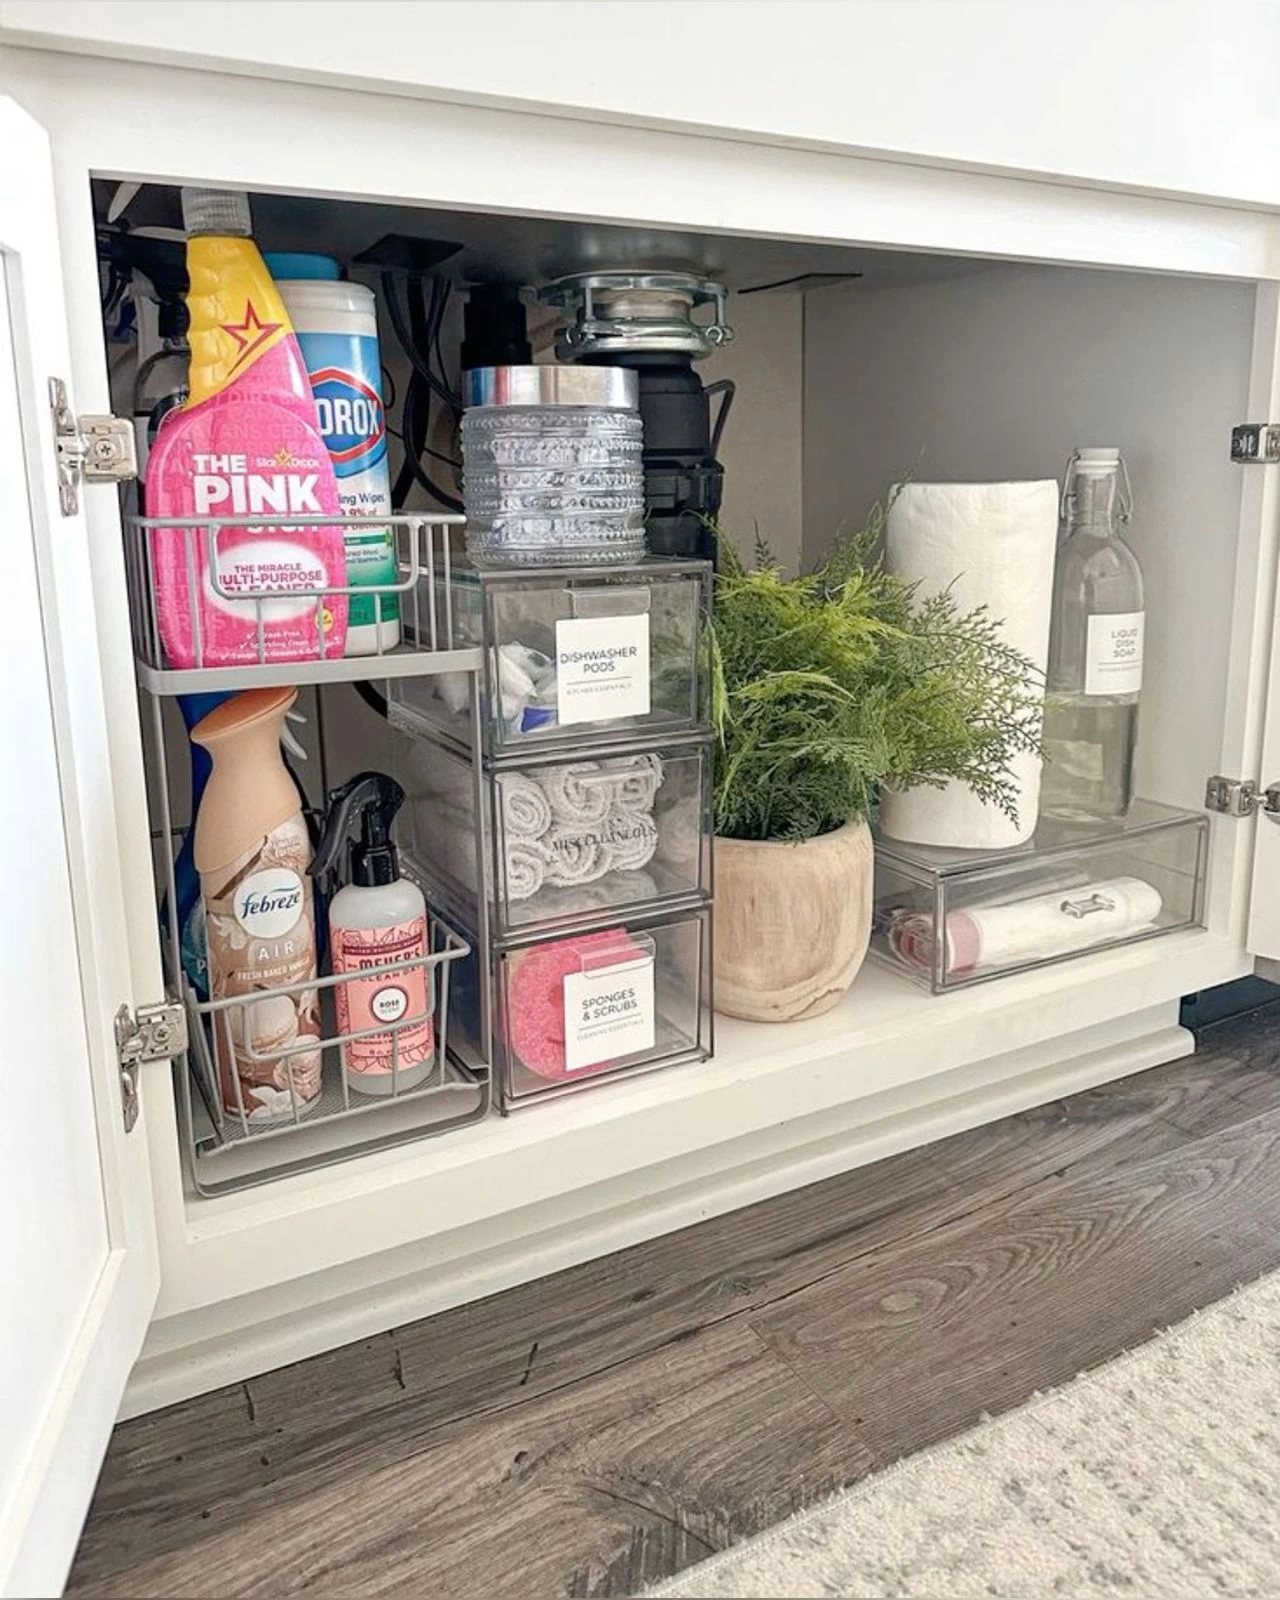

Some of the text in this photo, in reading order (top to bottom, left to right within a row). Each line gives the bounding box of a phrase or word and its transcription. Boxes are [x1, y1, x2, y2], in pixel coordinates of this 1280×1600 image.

[315, 398, 379, 435] OROX
[193, 454, 247, 473] THE
[193, 474, 322, 514] PINK
[337, 492, 356, 506] ing
[219, 570, 323, 585] ULTI-PURPOSE
[234, 562, 302, 574] THE MIRACLE
[560, 646, 638, 664] DISHWASHER
[583, 661, 616, 674] PODS
[241, 889, 301, 919] febreze
[257, 941, 295, 960] AIR
[379, 999, 400, 1008] ROSE
[582, 988, 636, 1010] SPONGES
[582, 999, 638, 1021] & SCRUBS
